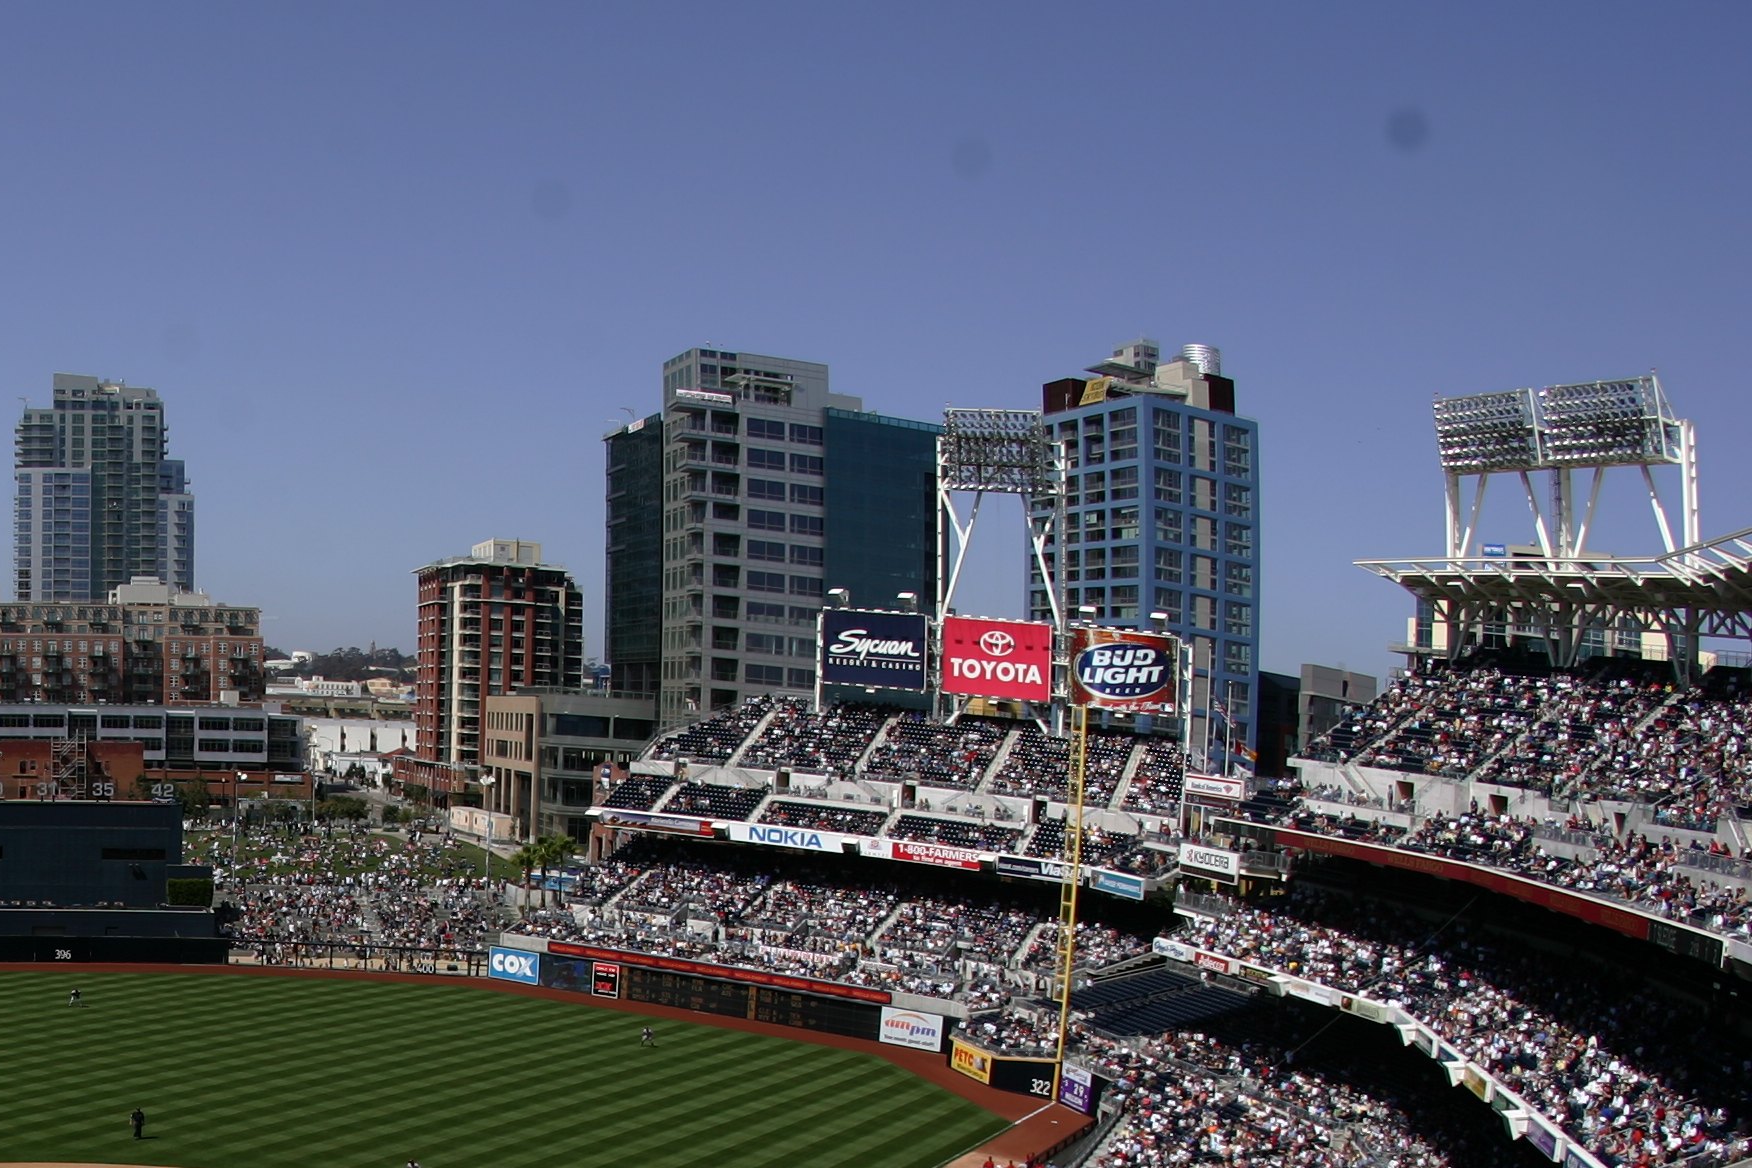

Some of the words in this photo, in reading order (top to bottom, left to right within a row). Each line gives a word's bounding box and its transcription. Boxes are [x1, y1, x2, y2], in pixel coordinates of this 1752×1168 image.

[829, 629, 919, 662] Sycuan
[829, 656, 869, 668] RESORT
[881, 660, 921, 672] CASINO
[1091, 648, 1156, 667] BUD
[950, 657, 1042, 686] TOYOTA
[1081, 665, 1164, 685] LIGHT
[37, 782, 57, 797] 31
[91, 783, 114, 797] 35
[150, 783, 174, 797] 42
[749, 827, 823, 849] NOKIA
[897, 844, 978, 863] 1-800-FARMERS
[1193, 850, 1229, 869] KYOCERA
[55, 949, 72, 960] 396
[416, 962, 434, 973] 400
[492, 953, 536, 977] COX
[884, 1019, 937, 1037] ampm
[1029, 1078, 1051, 1096] 322
